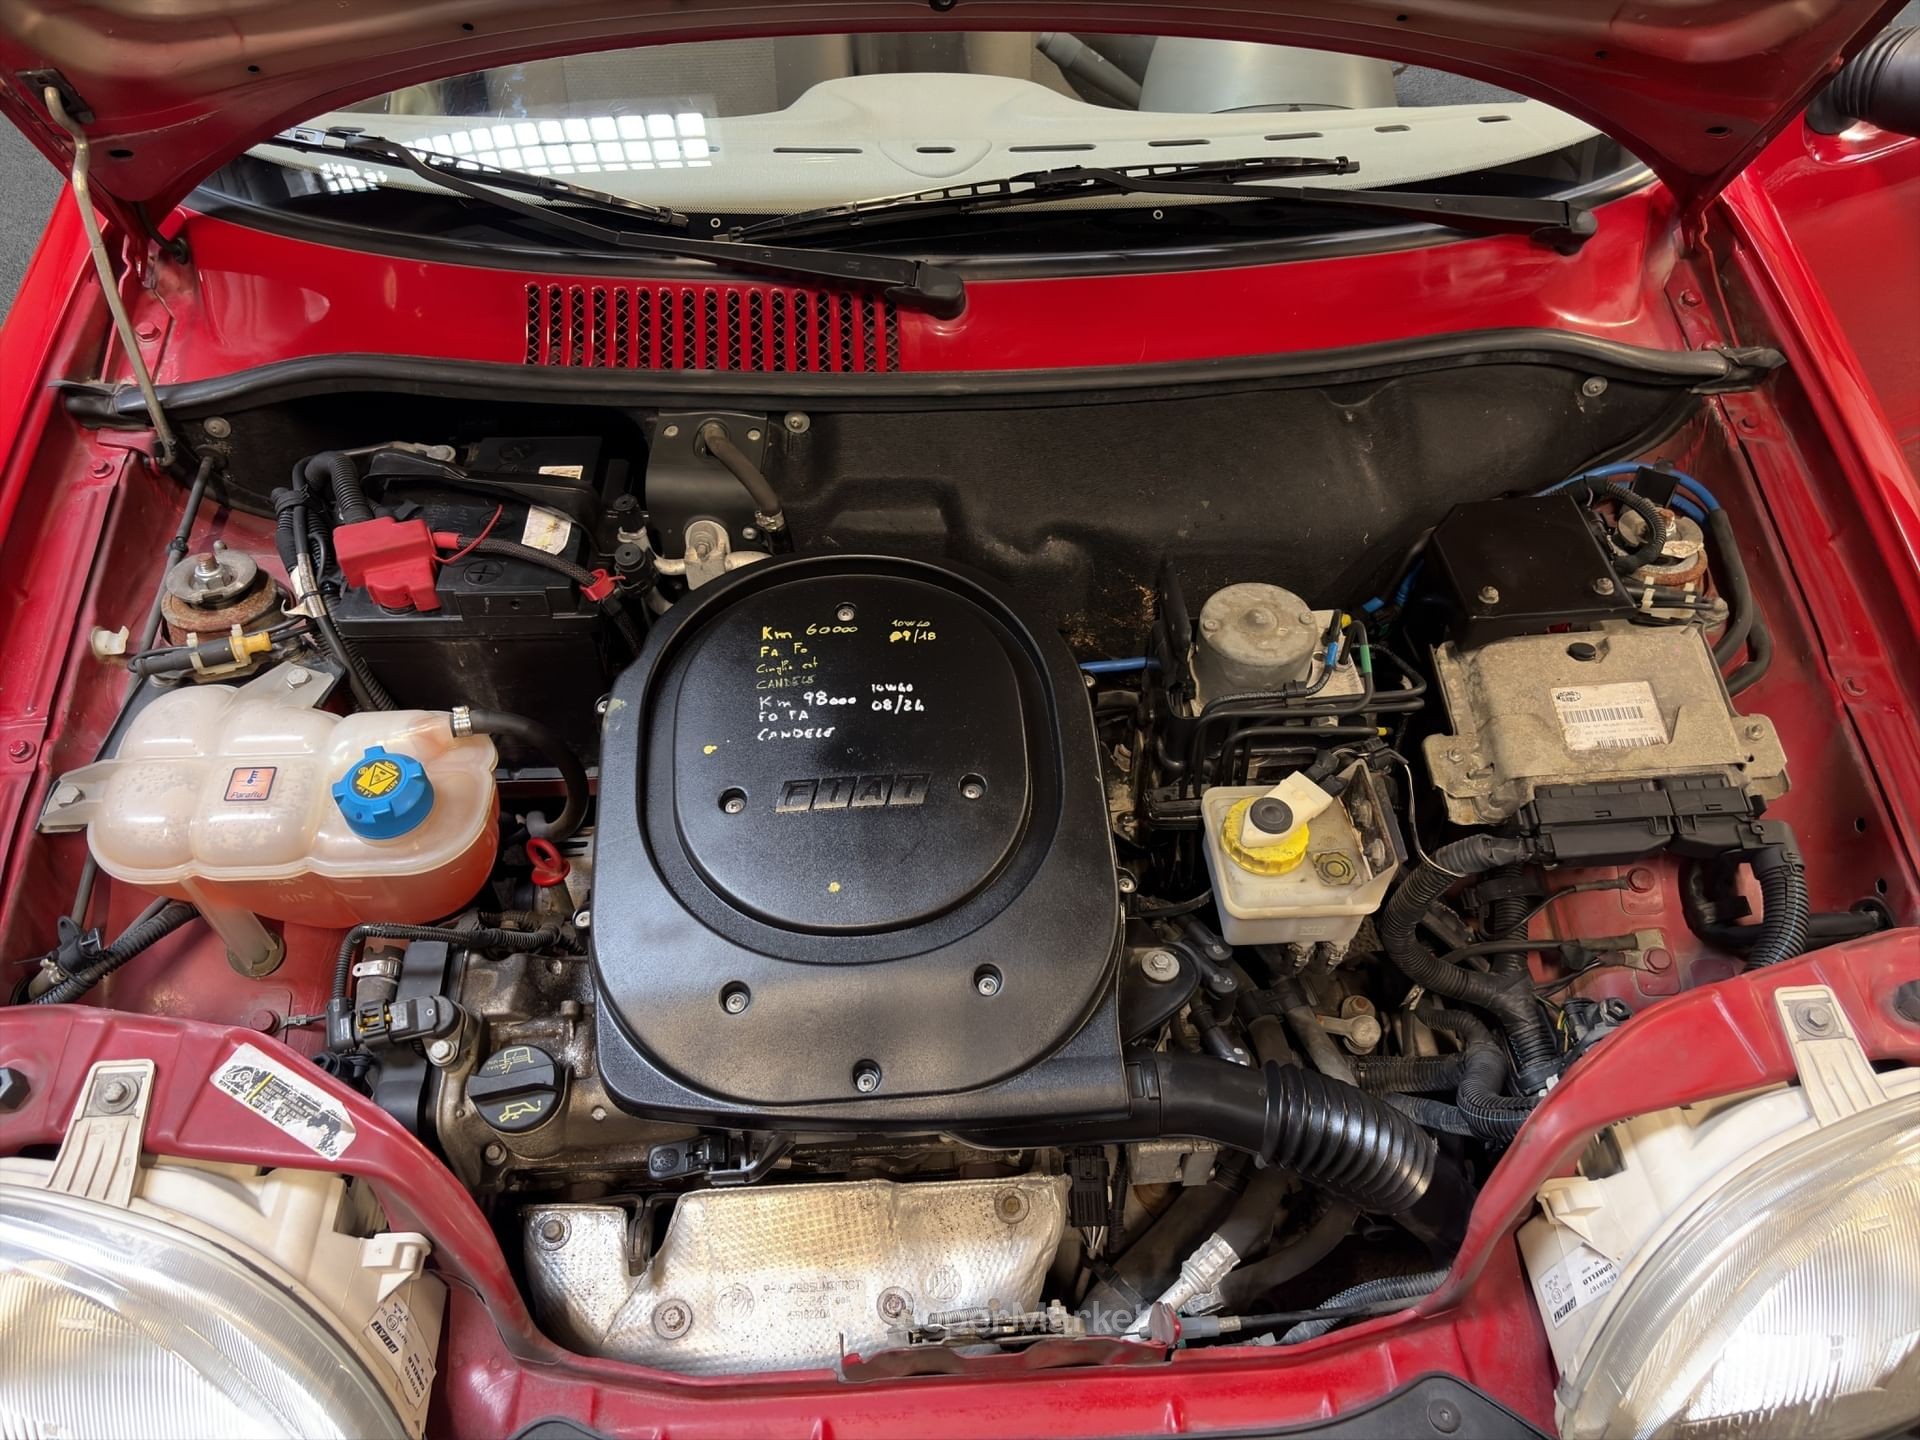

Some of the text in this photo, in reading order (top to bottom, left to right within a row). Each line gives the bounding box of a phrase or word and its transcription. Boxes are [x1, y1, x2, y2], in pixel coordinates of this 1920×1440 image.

[762, 623, 858, 640] Km 60000
[760, 646, 779, 658] FA
[759, 690, 857, 710] Km 98000
[871, 695, 925, 715] 08/24
[230, 791, 263, 799] Paraflu
[775, 773, 932, 813] FIAT
[1582, 1262, 1613, 1285] CARELLO
[371, 1320, 399, 1354] FIAT
